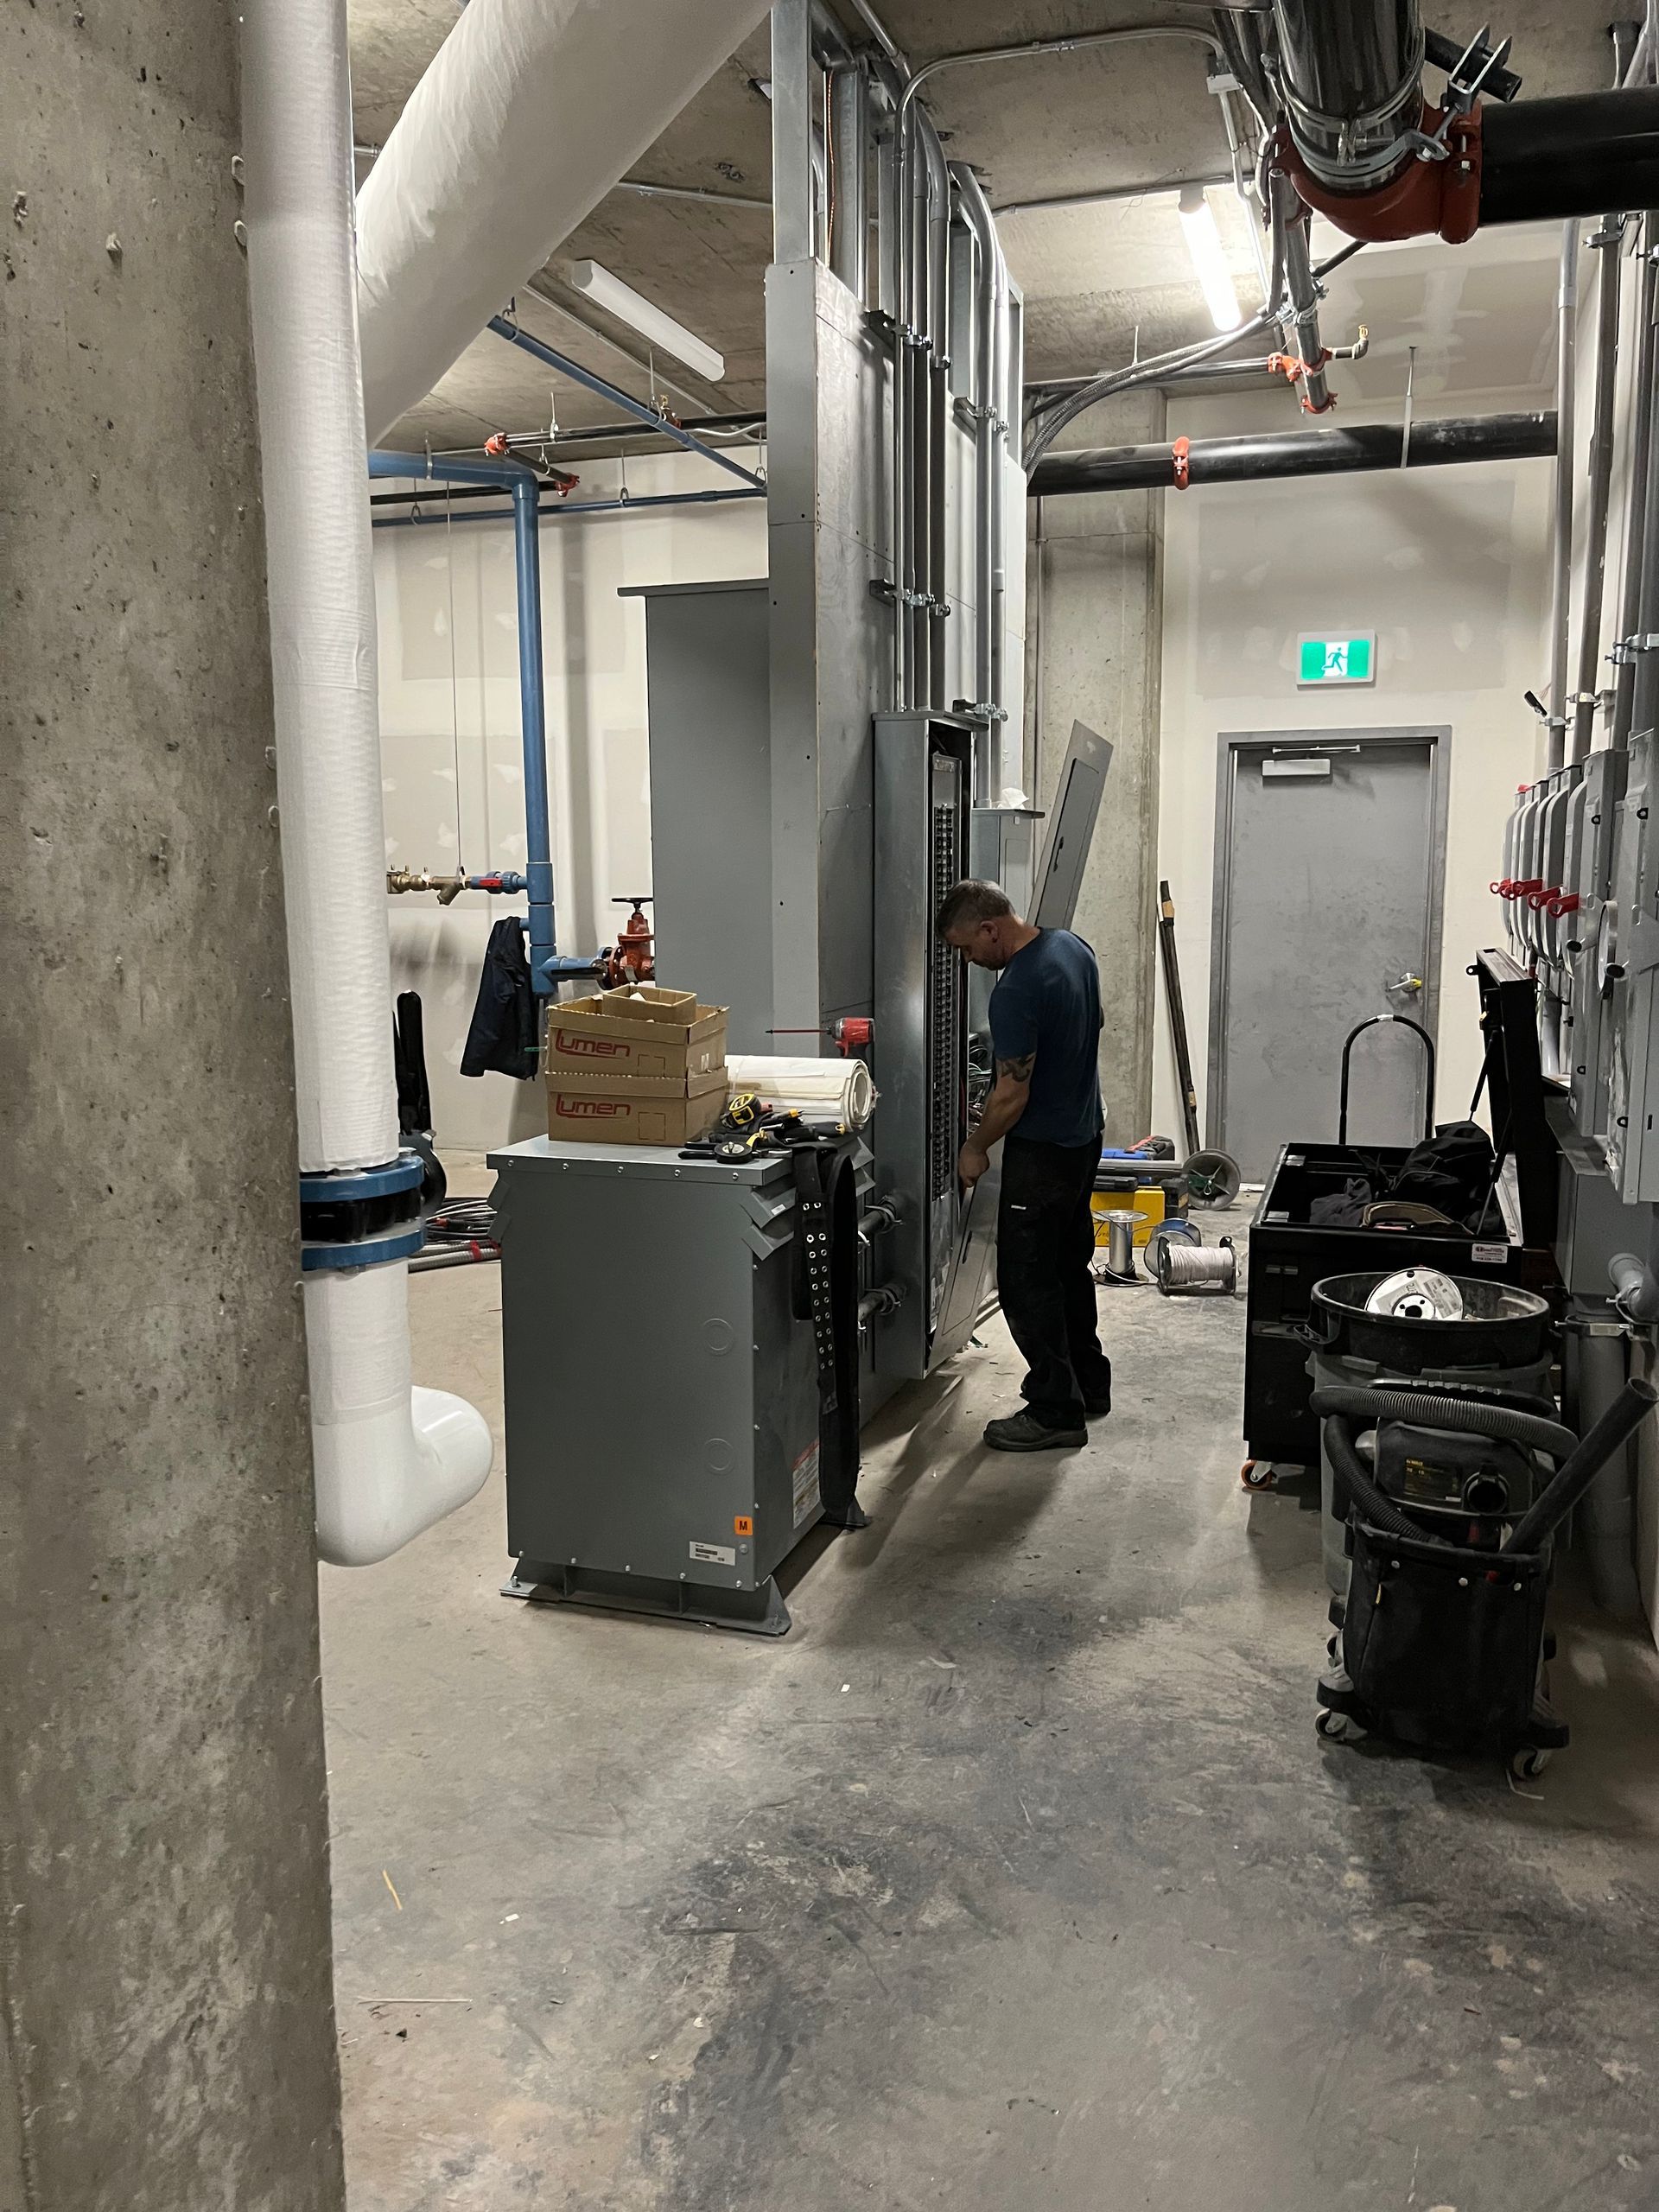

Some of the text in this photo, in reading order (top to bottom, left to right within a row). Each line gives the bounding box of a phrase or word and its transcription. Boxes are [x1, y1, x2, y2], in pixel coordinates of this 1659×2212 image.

[556, 1029, 630, 1058] Lumen
[556, 1093, 631, 1118] Lumen
[739, 1520, 747, 1530] M
